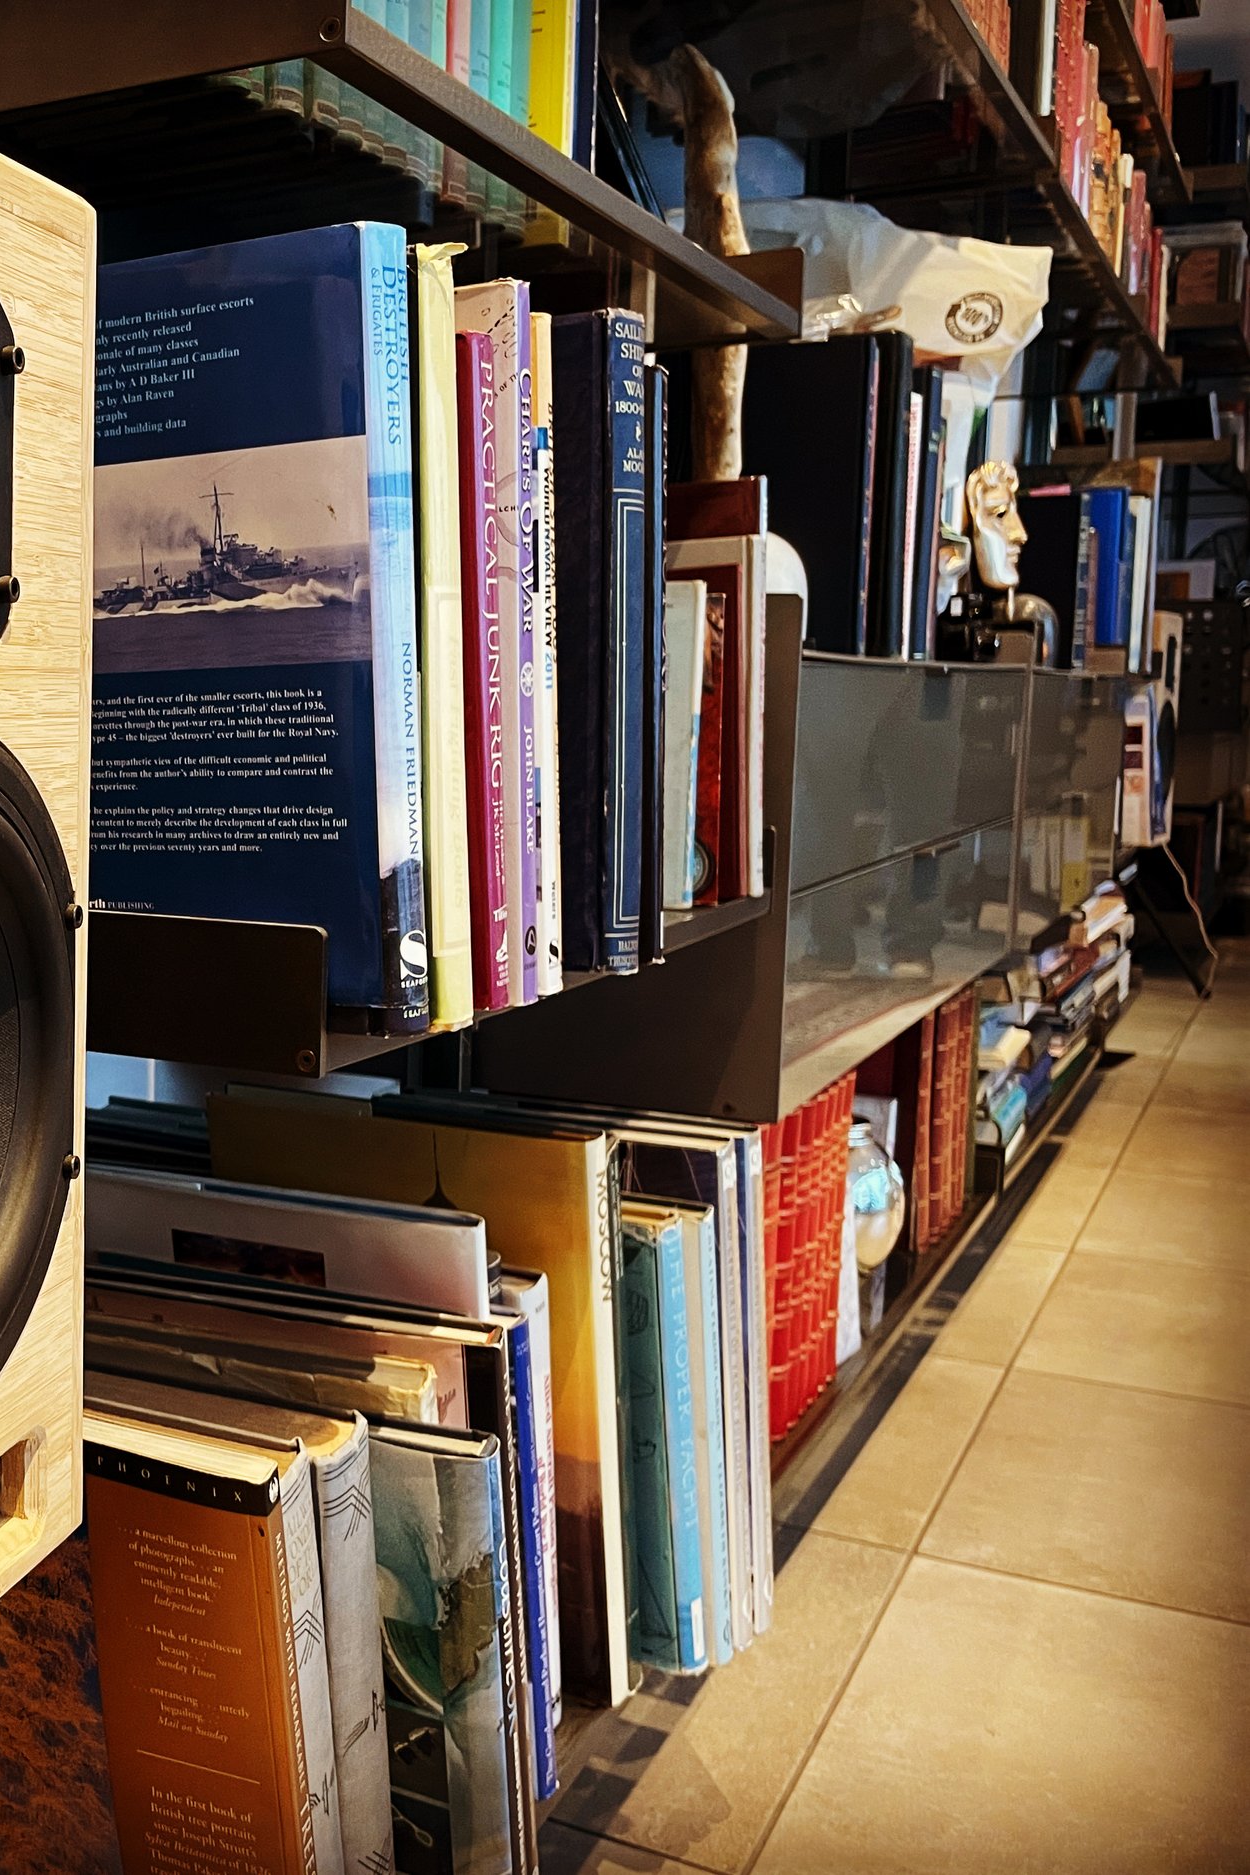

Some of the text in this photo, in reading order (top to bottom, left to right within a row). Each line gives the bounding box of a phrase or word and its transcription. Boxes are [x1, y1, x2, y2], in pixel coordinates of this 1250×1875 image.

[106, 297, 254, 328] modern British surface escorts
[371, 268, 382, 356] & FRIGATES
[113, 321, 192, 343] recently released
[126, 338, 199, 356] of many classes
[383, 266, 401, 445] DESTROYERS
[119, 348, 240, 373] Australian and Canadian
[116, 369, 194, 391] by A D Baker III
[107, 389, 174, 407] by Alan Raven
[104, 419, 186, 437] and building data
[480, 362, 498, 596] PRACTICAL
[519, 368, 534, 632] CHARTS OF WAR
[482, 609, 500, 714] JUNK
[124, 696, 135, 705] the
[138, 696, 154, 704] first
[200, 692, 230, 700] smaller
[233, 692, 264, 700] escorts,
[284, 689, 304, 698] book
[129, 701, 326, 716] with radically different class 1936,
[125, 714, 334, 730] through post-war which these traditional
[140, 733, 167, 742] biggest
[237, 730, 255, 738] built
[258, 729, 270, 737] for
[289, 728, 312, 738] Royal
[315, 728, 338, 738] Navy.
[402, 643, 419, 854] NORMAN FRIEDMAN
[490, 725, 502, 788] RIG
[106, 754, 326, 768] sympathetic view difficult economic political
[190, 769, 214, 779] ability
[228, 769, 263, 778] compare
[283, 767, 317, 776] contrast
[96, 783, 138, 792] experience.
[524, 726, 534, 854] JOHN BLAKE
[105, 805, 333, 816] explains policy strategy changes drive design
[137, 818, 347, 829] merely describe development class full
[122, 831, 153, 839] research
[190, 831, 221, 839] archives
[270, 831, 300, 841] entirely
[133, 844, 165, 852] previous
[168, 844, 195, 853] seventy
[198, 844, 219, 853] years
[596, 1170, 612, 1302] MOSCOW
[673, 1313, 692, 1421] PROPER
[98, 1456, 242, 1502] PHOENIX
[680, 1437, 698, 1528] YACHT
[142, 1529, 237, 1561] marvellous collection
[134, 1559, 177, 1580] eminently
[141, 1577, 185, 1596] intelligent
[154, 1595, 206, 1616] Independent
[152, 1624, 176, 1639] book
[191, 1637, 242, 1655] translucent
[275, 1532, 288, 1624] MEETINGS
[285, 1626, 295, 1677] WITH
[290, 1681, 306, 1793] REMARKABLE
[152, 1786, 162, 1798] In
[167, 1791, 182, 1803] the
[186, 1795, 206, 1811] first
[210, 1802, 236, 1819] book
